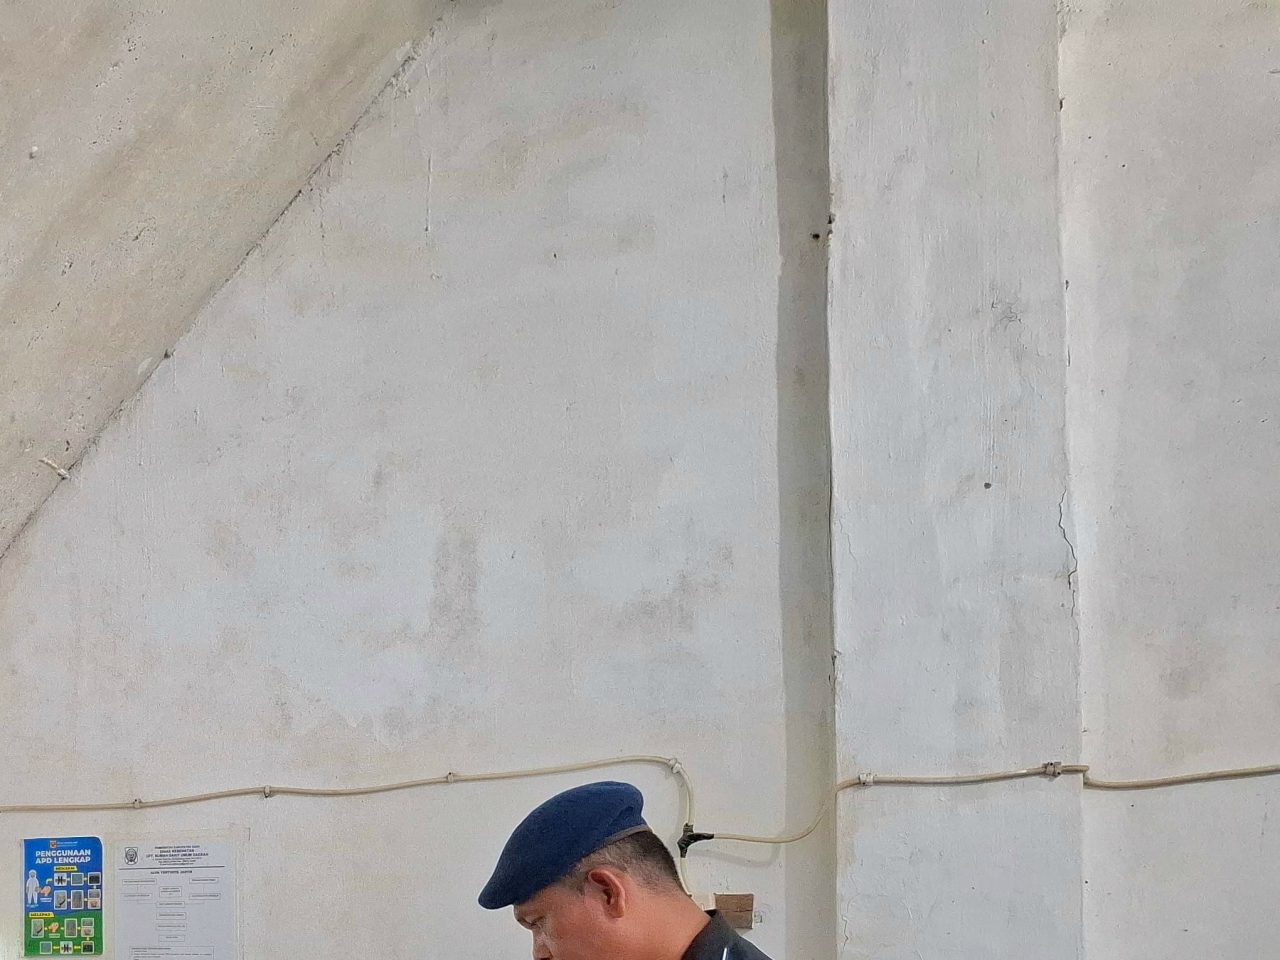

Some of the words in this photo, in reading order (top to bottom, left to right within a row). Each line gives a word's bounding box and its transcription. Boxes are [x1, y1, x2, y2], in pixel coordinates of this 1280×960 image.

[35, 849, 91, 857] PENGGUNAAN
[35, 857, 53, 865] APD
[53, 856, 91, 864] LENGKAP
